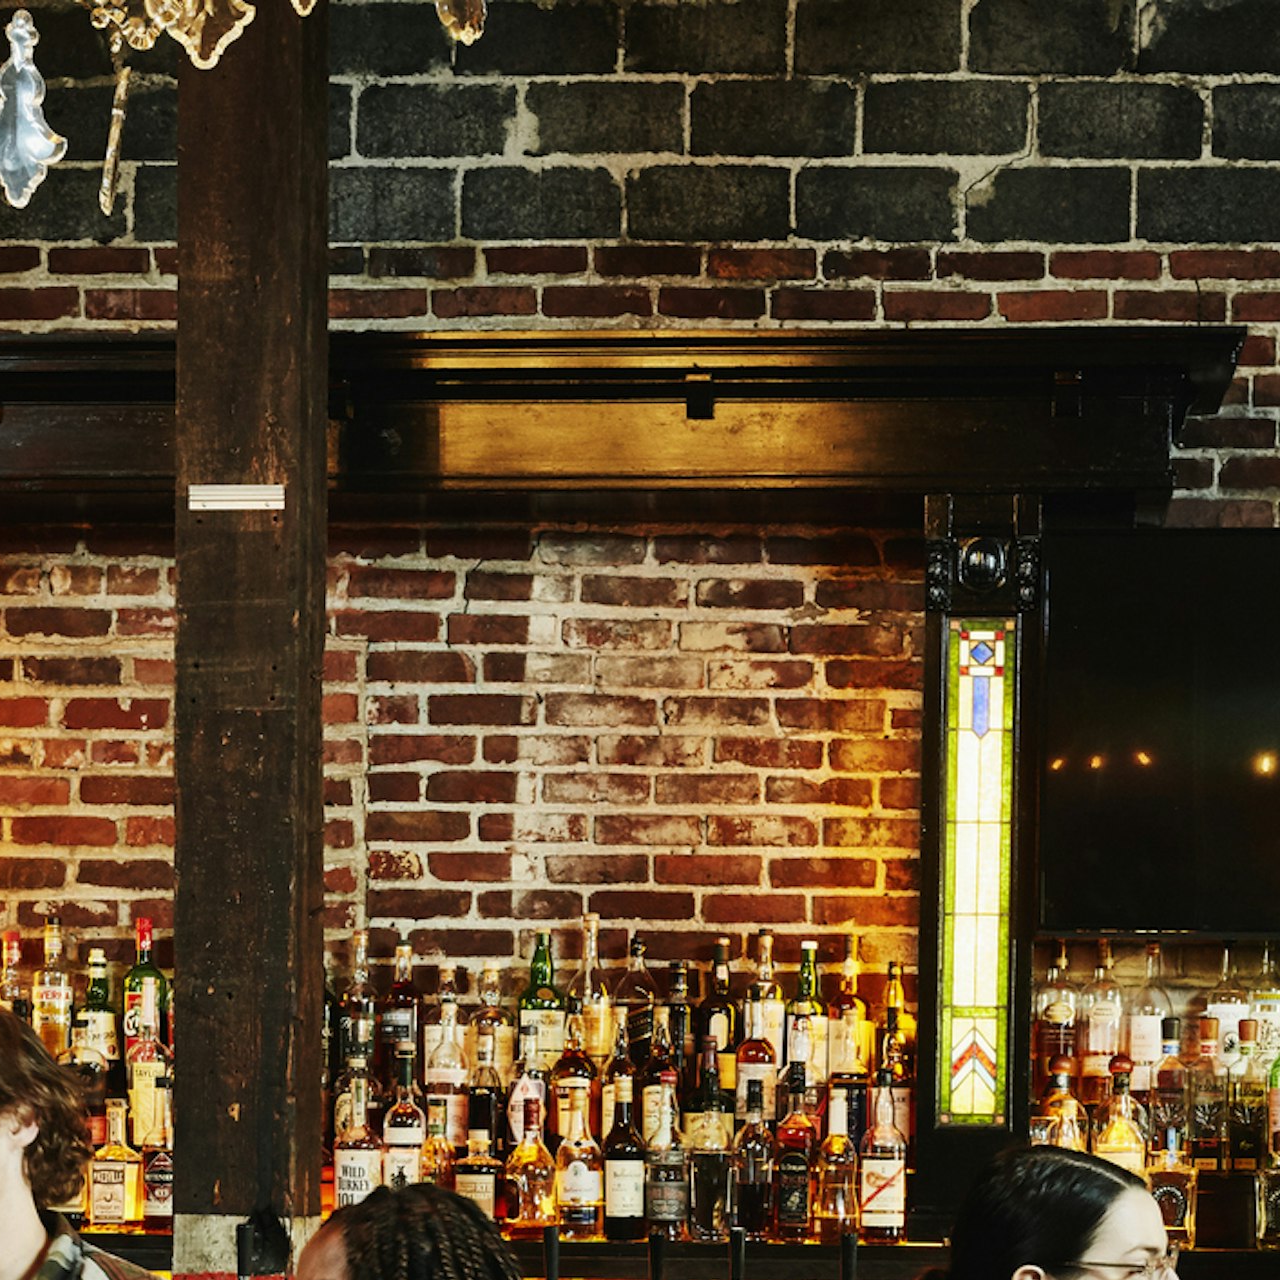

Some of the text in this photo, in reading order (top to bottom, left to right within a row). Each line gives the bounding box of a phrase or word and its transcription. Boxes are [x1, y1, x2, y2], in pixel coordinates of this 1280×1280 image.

[341, 1165, 366, 1177] WILD
[338, 1177, 370, 1191] TURKEY
[338, 1193, 355, 1207] 101
